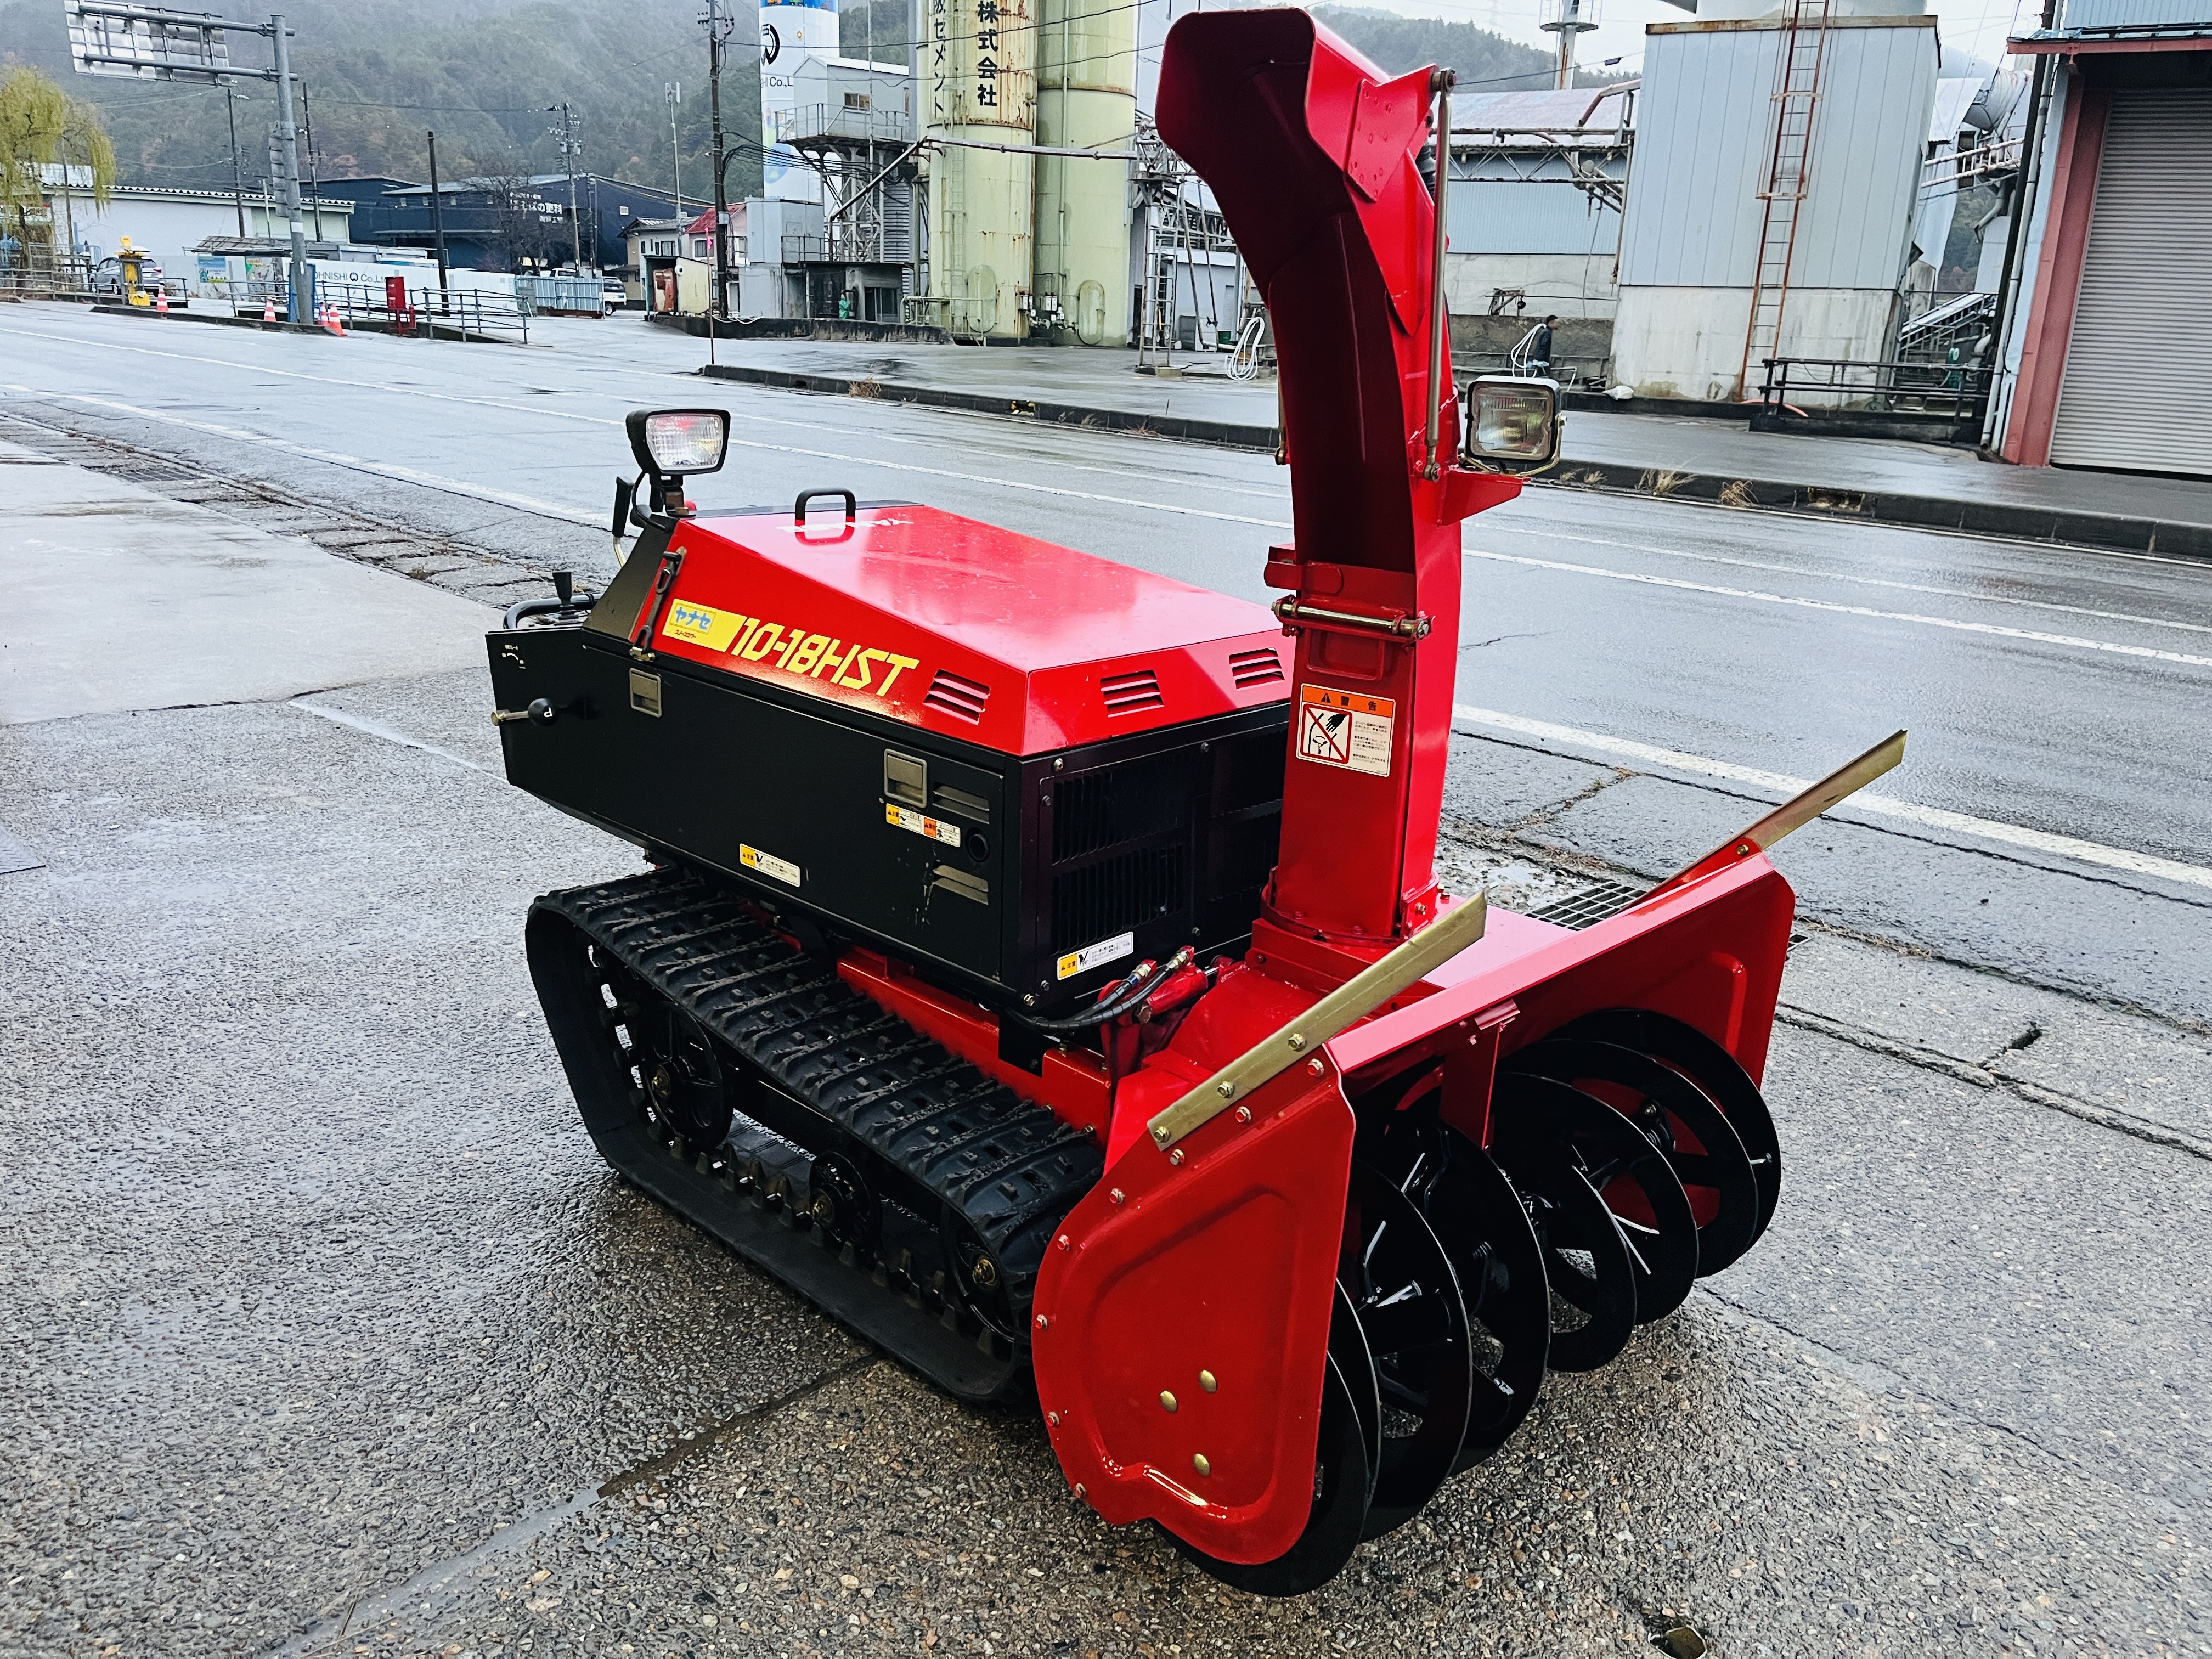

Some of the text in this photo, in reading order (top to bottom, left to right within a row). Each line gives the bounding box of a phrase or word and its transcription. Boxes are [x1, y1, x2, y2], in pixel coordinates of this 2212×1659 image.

[977, 1, 999, 106] 株式会社
[675, 606, 712, 630] ヤナセ
[731, 617, 920, 697] 10-18HST
